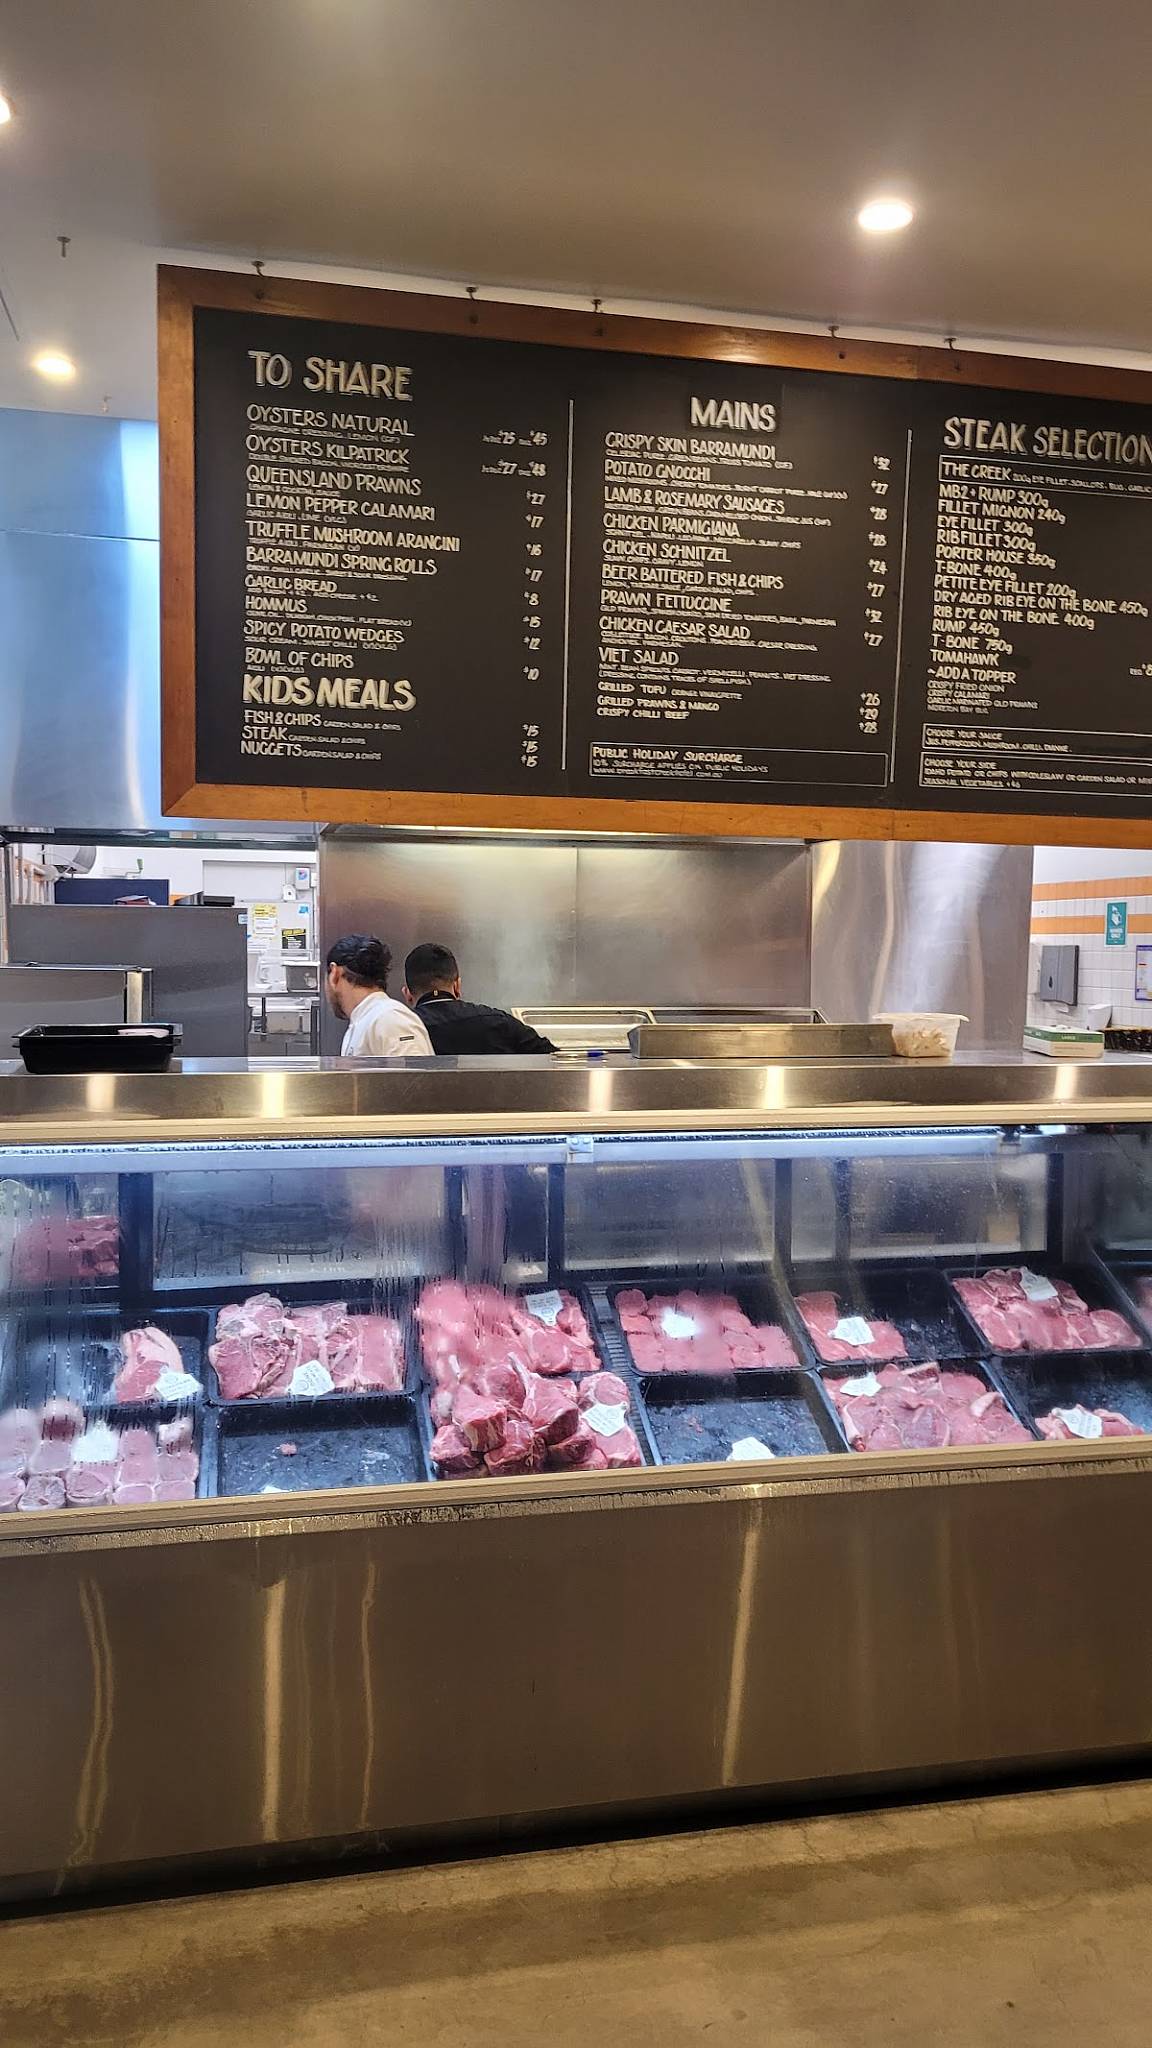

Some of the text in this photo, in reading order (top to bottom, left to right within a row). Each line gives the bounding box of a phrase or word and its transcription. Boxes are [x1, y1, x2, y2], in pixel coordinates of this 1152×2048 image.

[248, 350, 413, 401] TO SHARE
[247, 404, 328, 428] OYSTERS
[331, 413, 415, 437] NATURAL
[690, 396, 777, 432] MAINS
[605, 431, 655, 450] CRISPY
[657, 436, 687, 454] SKIN
[690, 439, 776, 460] BARRAMUNDI
[943, 416, 1027, 455] STEAK
[246, 434, 323, 457] OYSTERS
[326, 443, 410, 464] KILPATRICK
[246, 464, 422, 496] QUEENSLAND PRAWNS
[605, 459, 711, 482] POTATO GNOCCHI
[943, 461, 1012, 481] THE GREEK
[246, 493, 436, 521] LEMON PEPPER CALAMARI
[605, 485, 642, 504] LAMB
[644, 489, 653, 504] &
[655, 489, 722, 510] ROSEMARY
[722, 494, 785, 514] SAUSAGES
[978, 486, 1016, 503] RUMP
[1017, 491, 1049, 509] 300g
[938, 500, 1066, 526] FILLET MIGNON 240g
[245, 520, 311, 540] TRUFFLE
[313, 526, 393, 547] MUSHROOM
[396, 533, 461, 552] ARANCINI
[603, 513, 659, 532] CHICKEN
[662, 516, 741, 538] PARMIGIANA
[937, 515, 1034, 536] EYE FILLET 300g
[602, 539, 657, 558] CHICKEN
[660, 543, 732, 563] SCHNITZEL
[936, 529, 1036, 553] RIB FILLET 300g
[246, 547, 339, 568] BARRAMUNDI
[340, 553, 392, 572] SPRING
[394, 557, 438, 575] ROLLS
[936, 544, 1056, 569] PORTER HOUSE 350g
[602, 563, 638, 581] BEER
[640, 566, 704, 585] BATTERED
[935, 559, 1017, 581] T-BONE 400g
[245, 574, 337, 593] GARLIC BREAD
[933, 574, 1077, 599] PETITE EYE FILLET 200g
[245, 596, 308, 613] HOMMUS
[600, 589, 733, 613] PRAWN FETTUCCINE
[933, 590, 1148, 617] DRY AGED RIB EYE ON THE BONE 450g
[599, 616, 751, 640] CHICKEN CAESAR SALAD
[932, 618, 1000, 637] RUMP 450g
[933, 605, 1095, 630] RIB EYE ON THE BONE 400g
[243, 619, 405, 643] SPICY POTATO WEDGES
[931, 633, 1013, 655] T-BONE 750g
[245, 647, 355, 669] BOWL OF CHIPS
[598, 647, 680, 666] VIET SALAD
[929, 649, 1000, 667] TOMAHAWK
[961, 668, 971, 681] A
[971, 669, 1017, 684] TOPPER
[243, 674, 417, 711] KIDS MEALS
[597, 681, 636, 693] GRILLED
[640, 683, 668, 696] TOFU
[596, 707, 690, 720] CRISPY CHILLI BEEF
[597, 694, 635, 707] GRILLED
[636, 697, 678, 711] PRAWNS
[688, 700, 720, 712] MANGO
[242, 725, 288, 740] STEAK
[241, 740, 302, 757] NUGGETS
[592, 747, 744, 764] PUBLIC HOLIDAY SURCHARGE
[612, 759, 655, 769] SURCHARGE
[657, 761, 687, 770] APPLIES
[705, 764, 730, 772] PUBLIC
[731, 765, 769, 773] HOLIDAYS
